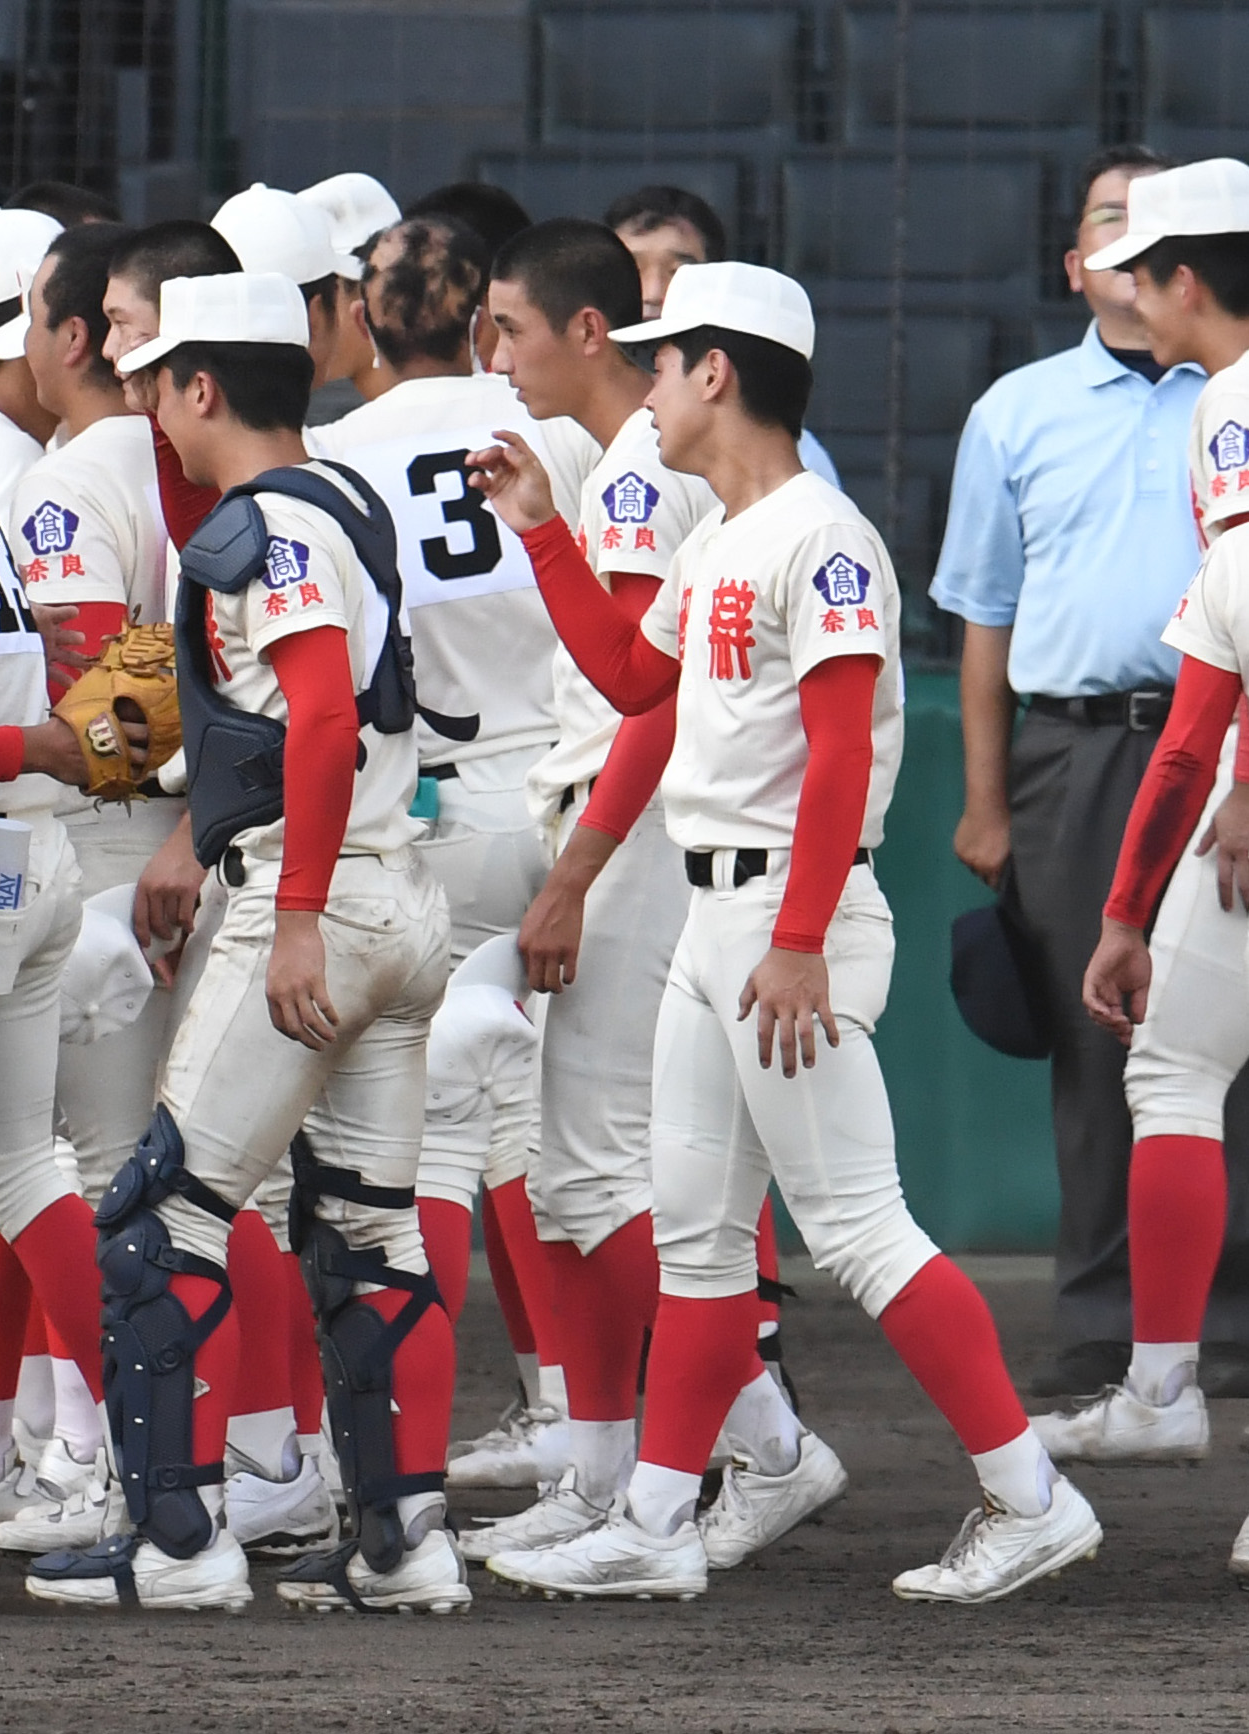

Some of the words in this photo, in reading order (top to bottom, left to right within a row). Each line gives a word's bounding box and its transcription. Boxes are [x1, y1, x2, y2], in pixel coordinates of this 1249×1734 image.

[406, 448, 503, 581] 3
[601, 525, 657, 552] 奈良
[26, 554, 85, 583] 奈良
[262, 582, 324, 618] 奈良
[820, 607, 879, 633] 奈良
